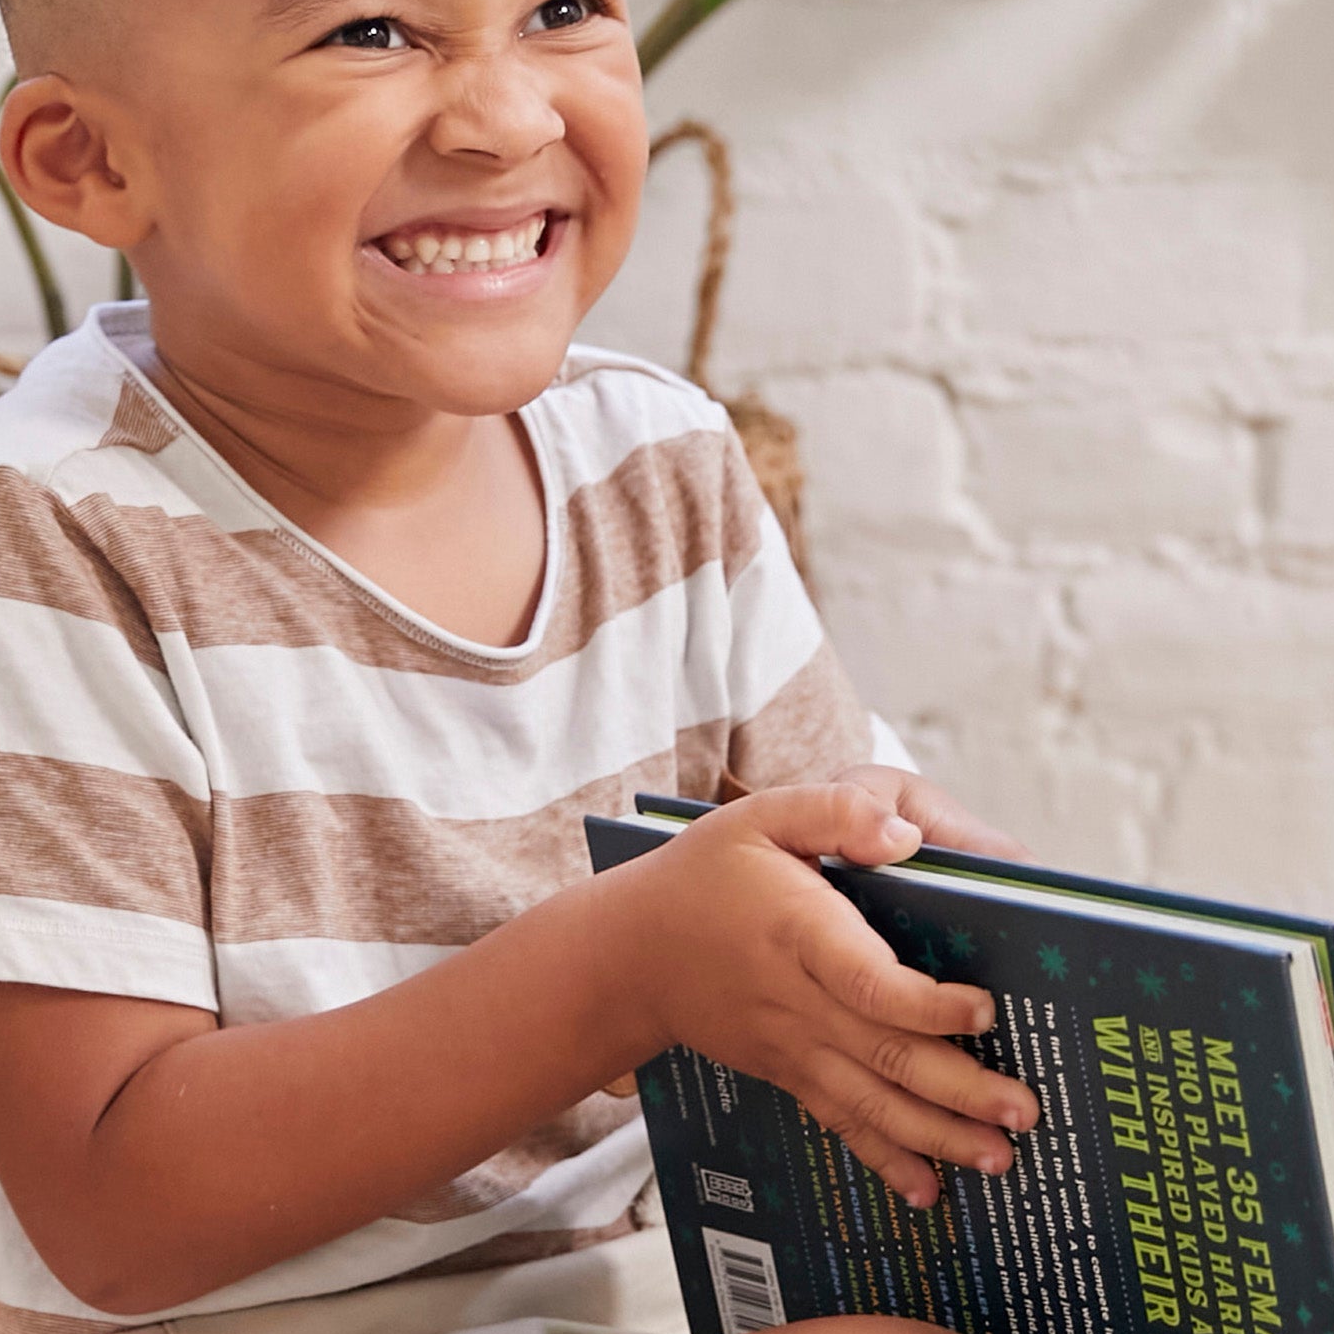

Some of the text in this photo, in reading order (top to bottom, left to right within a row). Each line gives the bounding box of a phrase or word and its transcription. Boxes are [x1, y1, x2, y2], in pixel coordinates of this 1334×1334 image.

[1020, 996, 1036, 1027] one
[1040, 999, 1058, 1031] The
[990, 1037, 1003, 1057] an
[1001, 992, 1029, 1083] snowboarde
[1027, 1030, 1046, 1080] tennis
[1047, 1034, 1065, 1067] first
[1135, 1023, 1164, 1065] AND
[711, 1061, 734, 1115] chette
[1088, 1008, 1152, 1155] WITH
[1166, 1024, 1204, 1106] WHO
[1035, 1081, 1056, 1132] player
[1053, 1070, 1074, 1127] woman
[1199, 1034, 1253, 1159] MEET
[1026, 1127, 1047, 1184] landed
[1046, 1134, 1060, 1152] in
[1050, 1154, 1066, 1183] the
[1064, 1130, 1085, 1175] horse
[1143, 1070, 1195, 1225] INSPIRED
[802, 1138, 830, 1228] JEN WELTER
[819, 1136, 850, 1243] MYERS TAYLOR
[1021, 1198, 1031, 1210] a
[1036, 1181, 1047, 1193] a
[1072, 1177, 1095, 1229] jockey
[1181, 1111, 1230, 1246] PLAYED
[1222, 1164, 1265, 1226] 35
[847, 1185, 868, 1244] ROUSEY
[864, 1181, 885, 1242] PATRICK
[997, 1170, 1022, 1247] ailblazers
[1056, 1185, 1076, 1235] world.
[907, 1221, 927, 1273] JACKIE
[953, 1175, 989, 1316] GRETCHEN BLEILER
[987, 1226, 1007, 1269] using
[1011, 1248, 1024, 1269] on
[1023, 1213, 1048, 1284] ballerina,
[1037, 1193, 1070, 1299] death-defying
[1066, 1238, 1079, 1253] A
[1083, 1232, 1098, 1251] to
[1117, 1165, 1183, 1329] THEIR
[822, 1239, 844, 1296] SERENA
[861, 1258, 880, 1307] WILMA
[879, 1256, 898, 1308] MEGAN
[895, 1254, 915, 1305] NANCY
[935, 1270, 951, 1303] LISA
[951, 1258, 970, 1307] SASHA
[996, 1268, 1014, 1304] their
[1016, 1270, 1031, 1296] the
[1069, 1255, 1089, 1302] surfer
[1086, 1254, 1111, 1322] compete
[1172, 1229, 1210, 1309] KIDS
[1037, 1286, 1053, 1317] and
